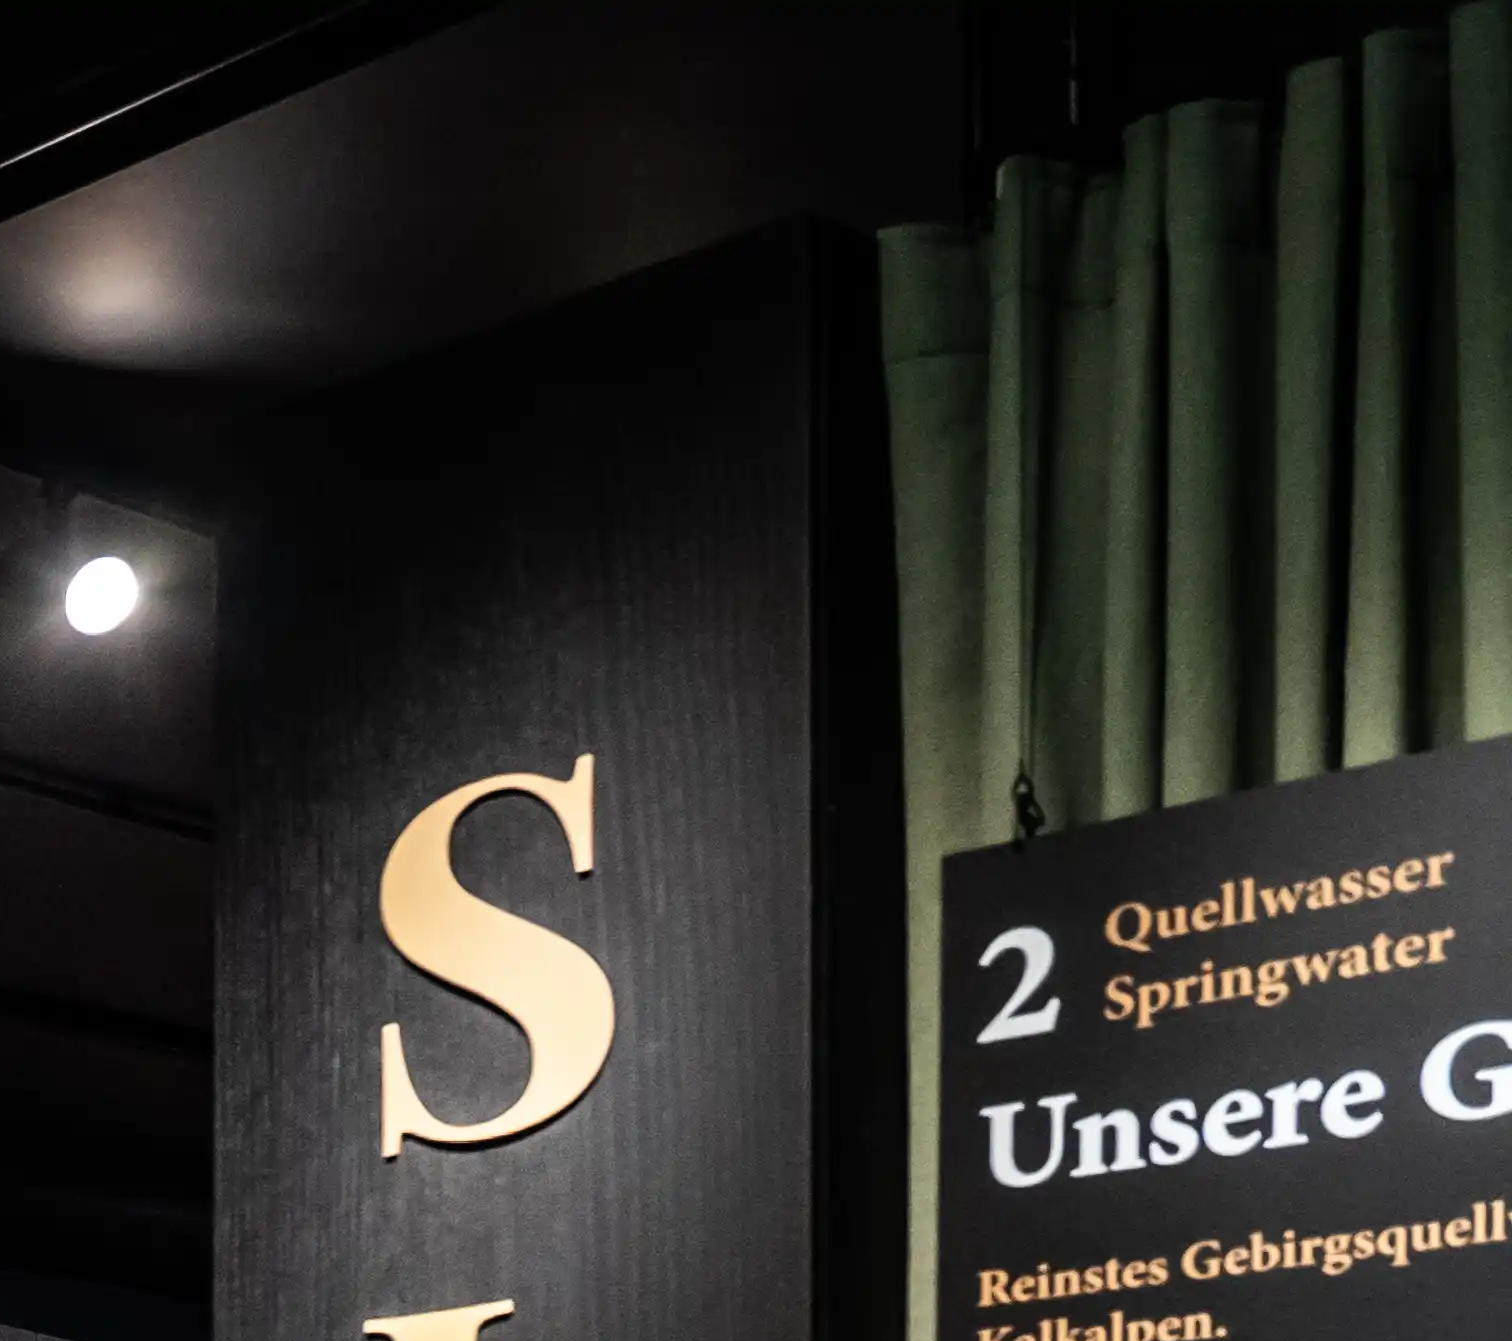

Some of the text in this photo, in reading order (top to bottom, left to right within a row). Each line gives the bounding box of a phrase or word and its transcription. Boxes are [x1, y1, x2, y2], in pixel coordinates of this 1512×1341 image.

[1103, 851, 1455, 952] Quellwasser
[976, 925, 1060, 1045] 2
[1102, 927, 1455, 1029] Springwater
[978, 1068, 1386, 1189] Unsere
[976, 1197, 1512, 1308] Reinstes Gebirgsquell
